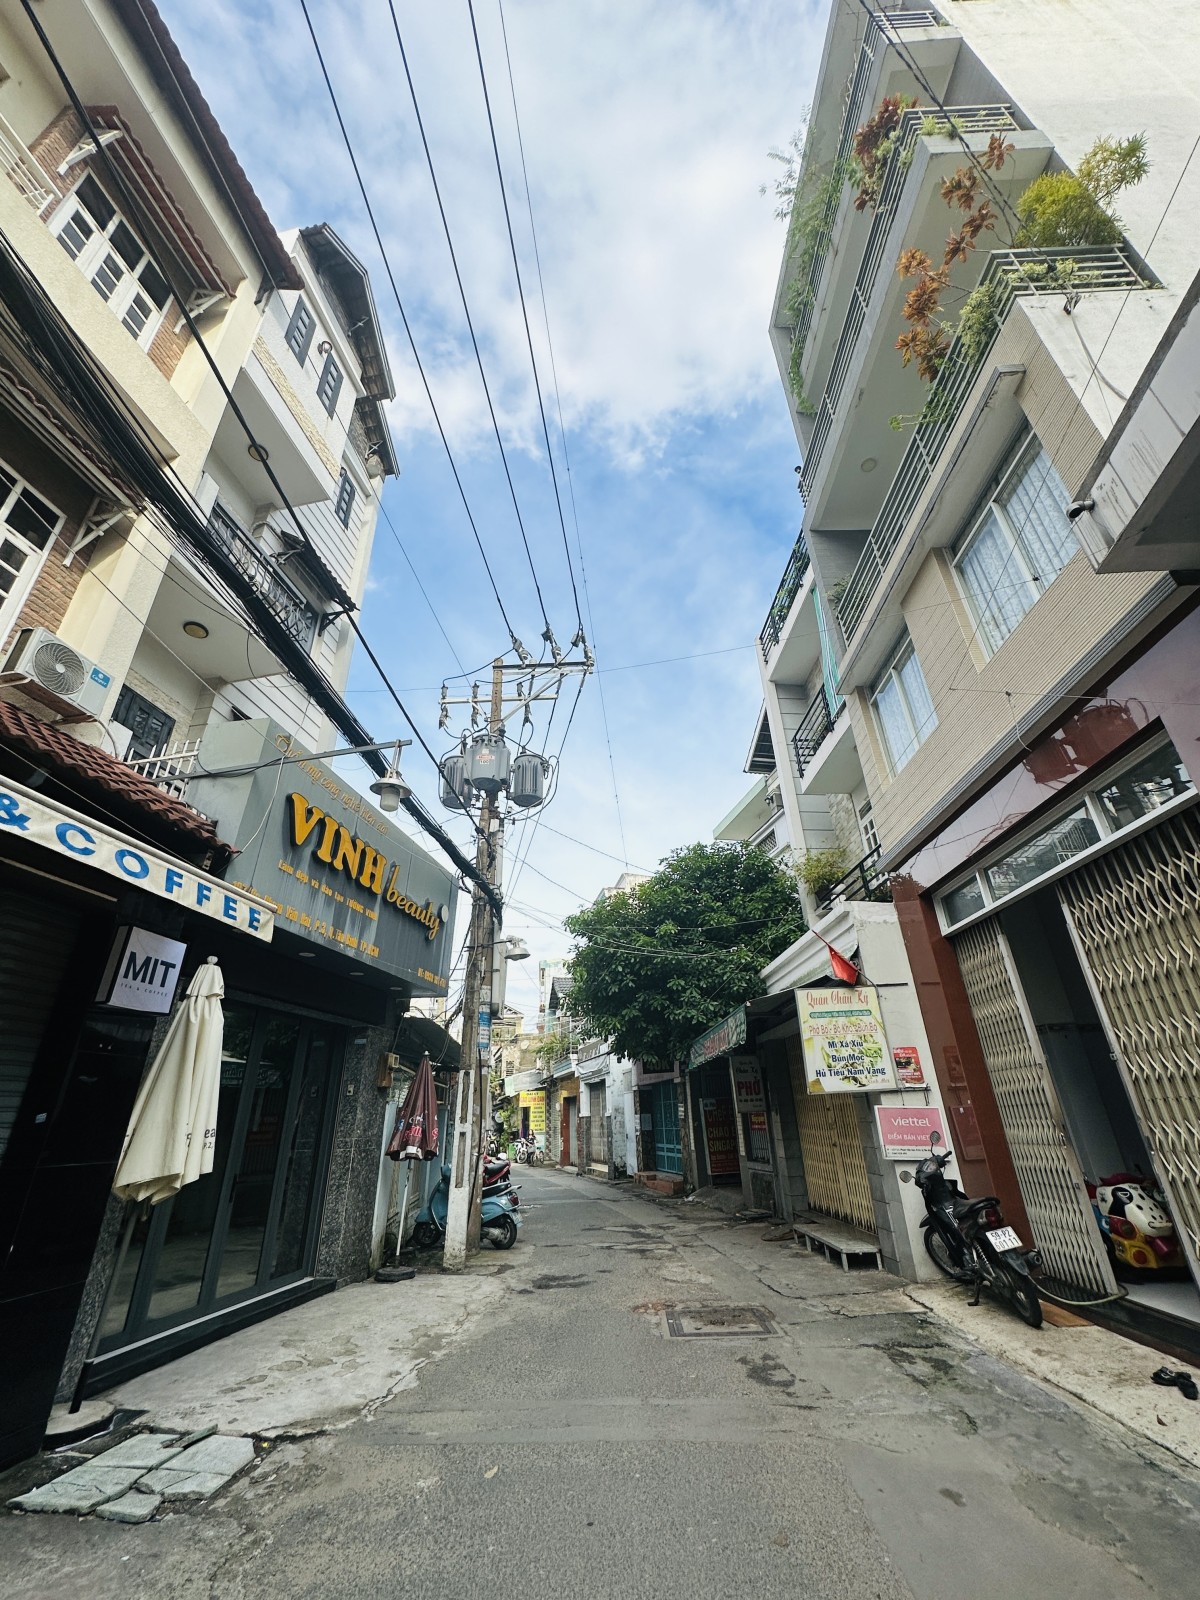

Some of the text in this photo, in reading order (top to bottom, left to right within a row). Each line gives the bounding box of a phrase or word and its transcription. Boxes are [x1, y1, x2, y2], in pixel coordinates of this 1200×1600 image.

[291, 792, 440, 941] VINH beauty
[55, 822, 262, 932] COFFEE
[122, 951, 176, 988] MIT
[806, 991, 829, 1009] Quán
[830, 989, 852, 1006] Châu
[848, 1053, 865, 1063] Mọc
[816, 1068, 827, 1078] Hủ
[828, 1066, 845, 1077] Tiếu
[847, 1067, 865, 1076] Nam
[866, 1066, 886, 1076] Vang
[736, 1075, 761, 1097] PHỞ
[891, 1116, 932, 1127] viettel
[887, 1131, 931, 1141] ĐIỂM BÁN VIET
[991, 1229, 1012, 1241] 59-P2
